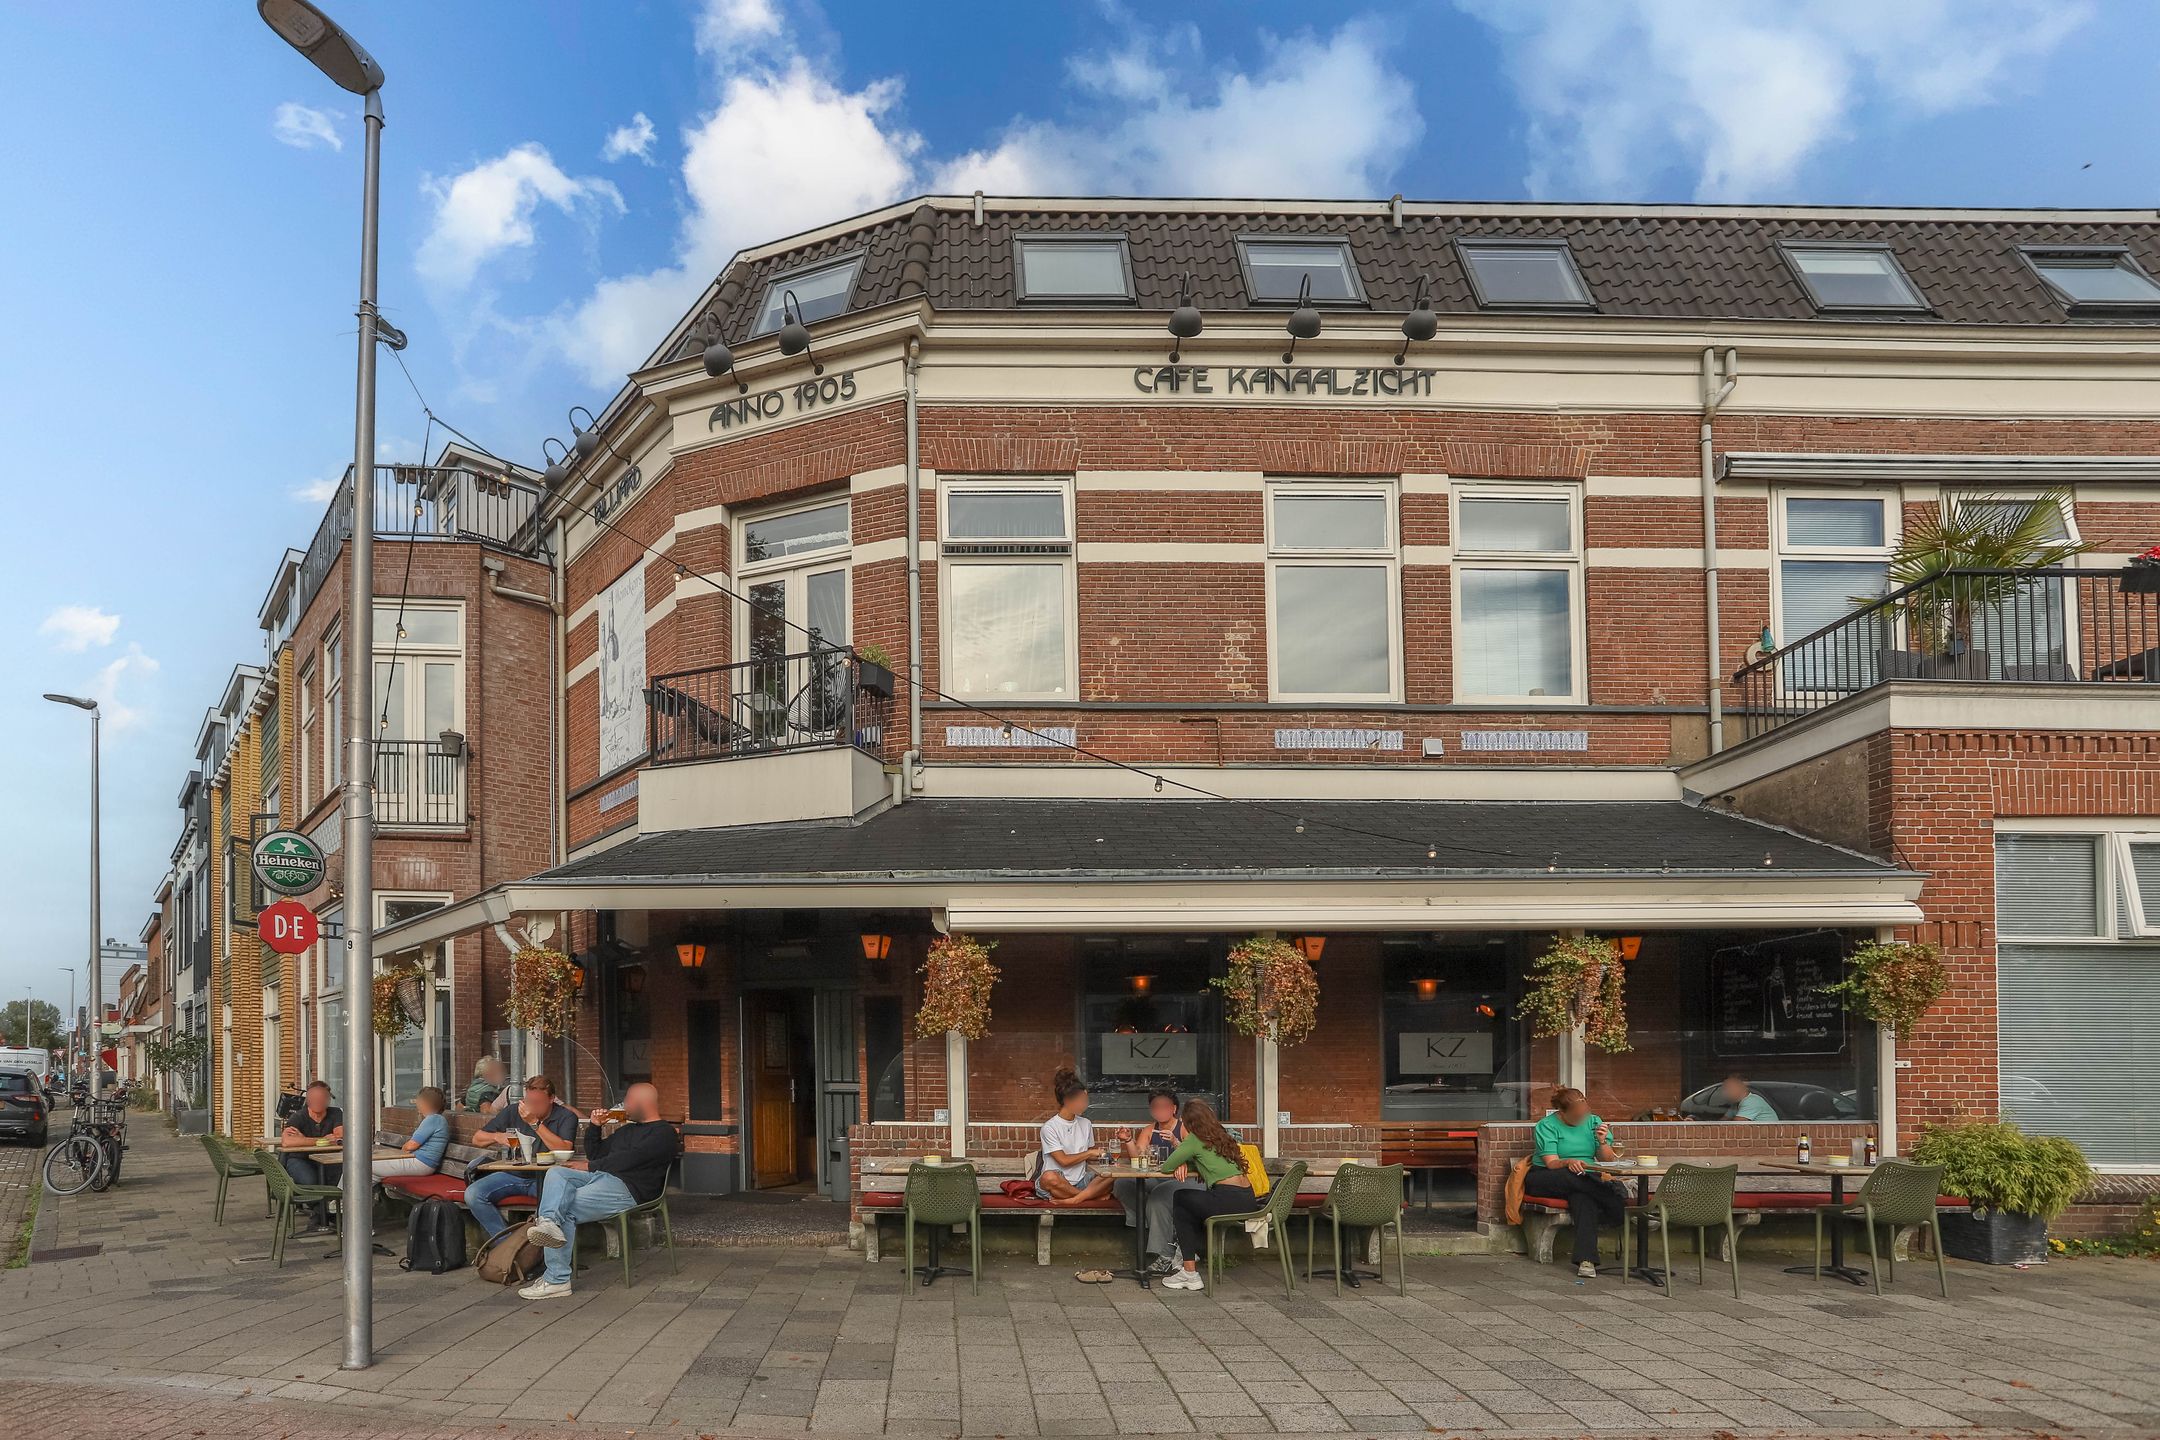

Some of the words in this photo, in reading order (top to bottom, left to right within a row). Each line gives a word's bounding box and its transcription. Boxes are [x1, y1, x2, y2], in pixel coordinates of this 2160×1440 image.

[1134, 366, 1214, 395] CAFE
[1228, 366, 1438, 396] KANAALZICHT
[708, 391, 784, 432] ANNO
[793, 372, 856, 412] 1905
[258, 854, 320, 869] Heineken
[1130, 1038, 1170, 1058] KZ
[1427, 1037, 1467, 1058] KZ
